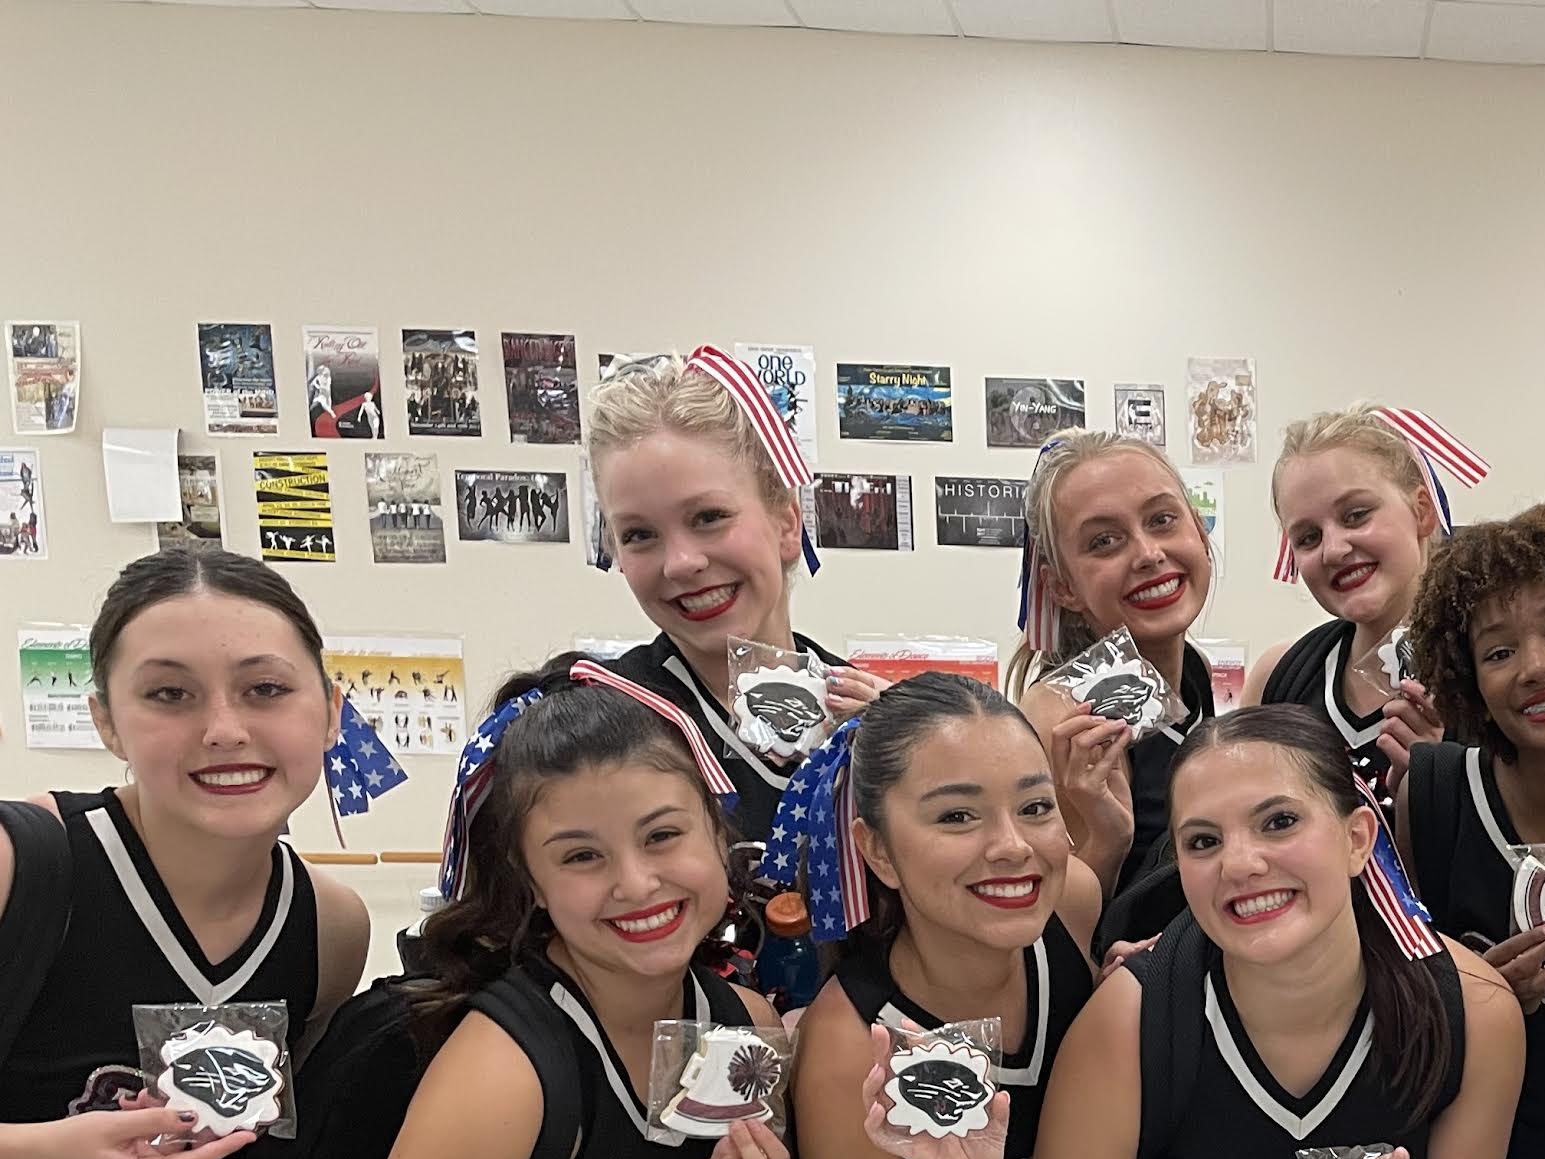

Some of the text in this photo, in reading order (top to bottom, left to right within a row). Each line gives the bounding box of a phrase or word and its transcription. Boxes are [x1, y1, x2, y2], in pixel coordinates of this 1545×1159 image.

[758, 369, 806, 386] ORLD
[869, 371, 927, 388] Starry Night
[259, 474, 326, 490] CONSTRUCTION
